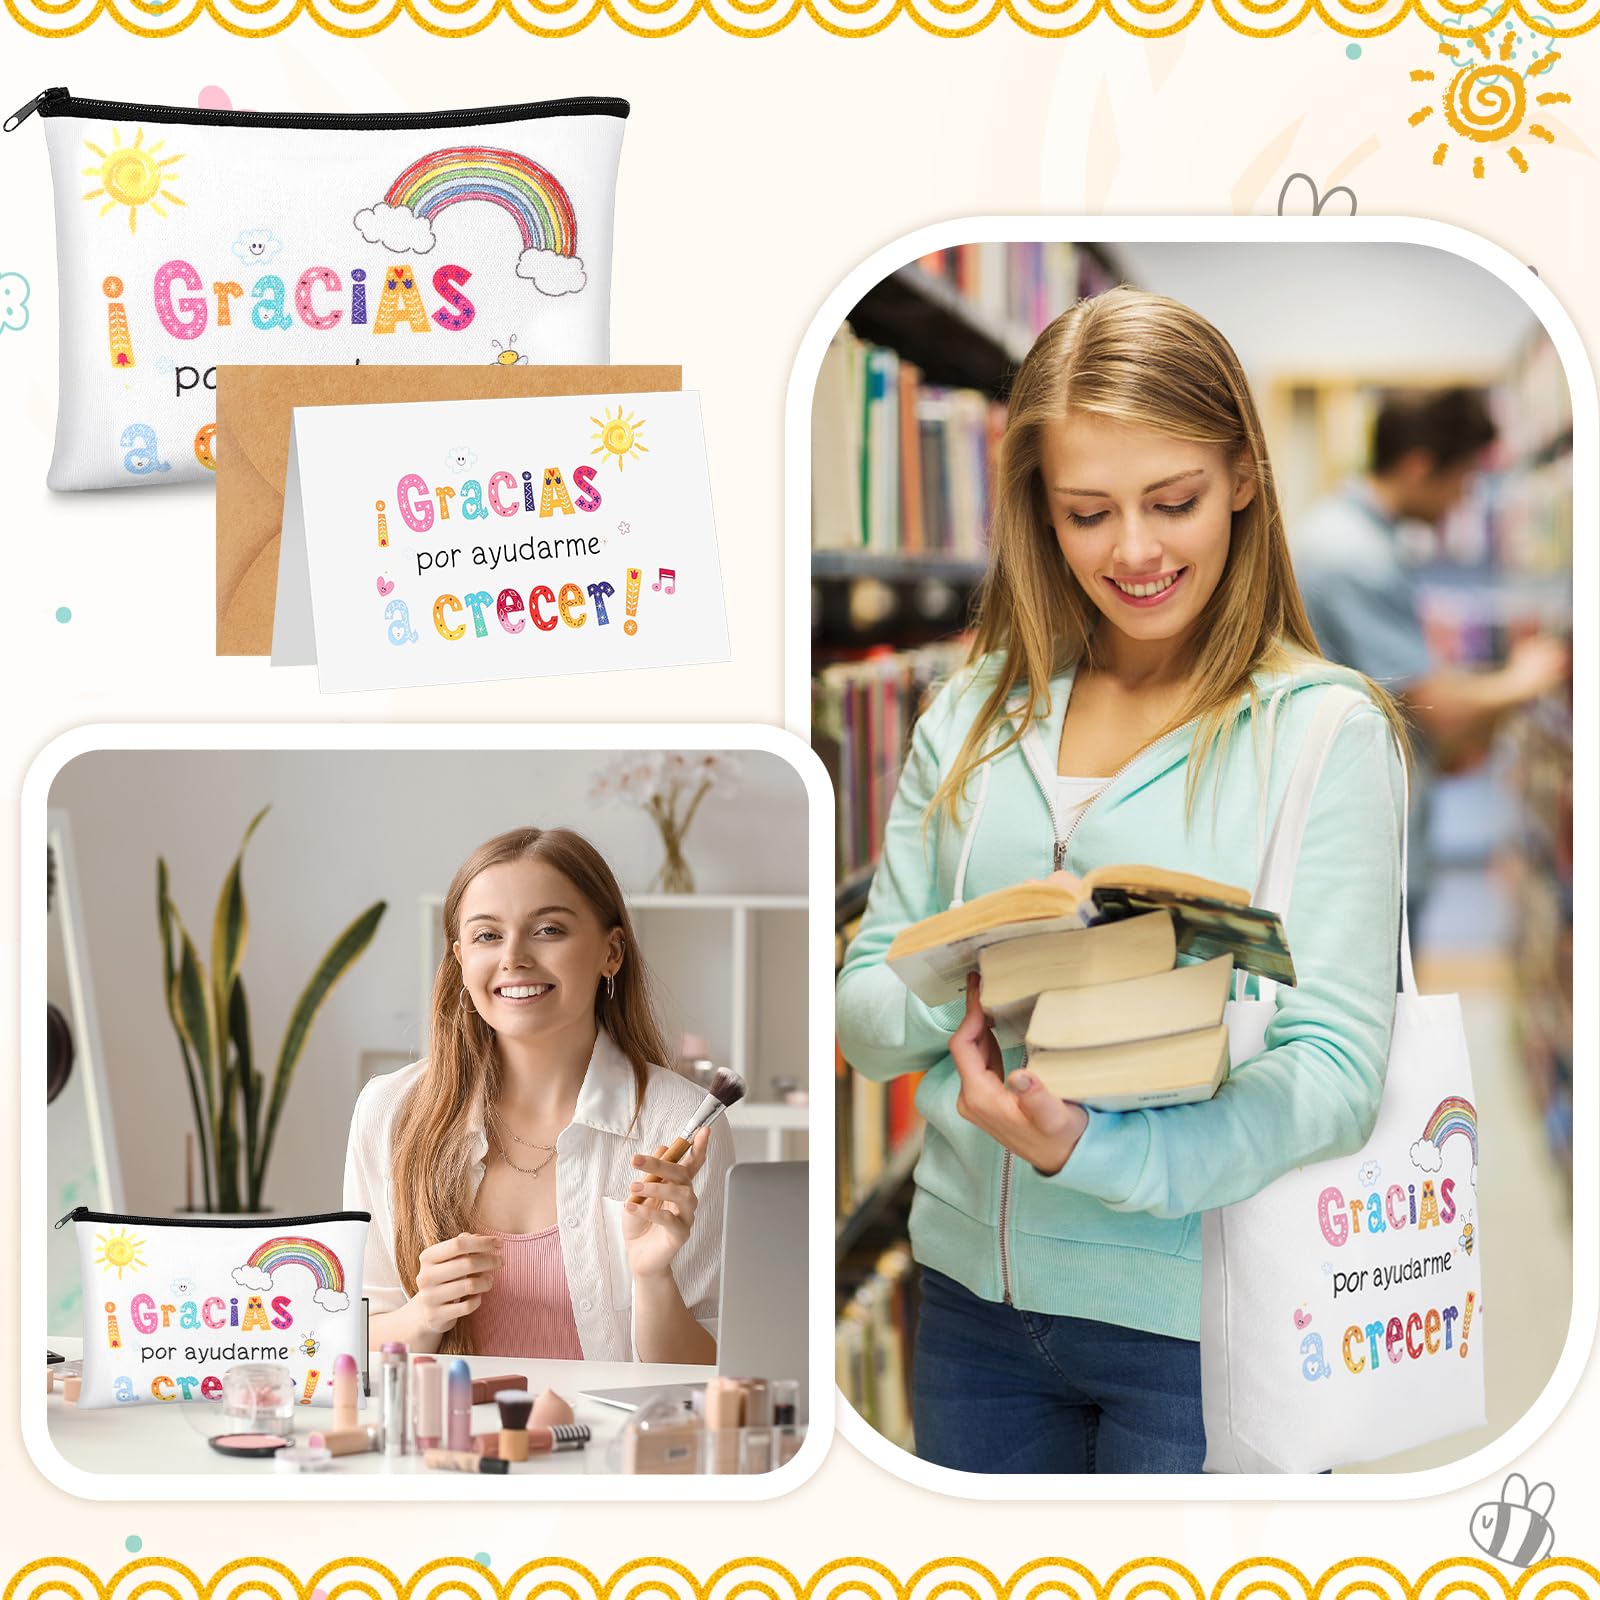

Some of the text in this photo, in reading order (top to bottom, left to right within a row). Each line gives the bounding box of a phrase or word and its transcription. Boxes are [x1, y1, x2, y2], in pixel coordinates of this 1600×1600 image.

[175, 366, 216, 397] po
[120, 423, 172, 475] a
[416, 536, 601, 576] por ayudarme
[384, 567, 642, 646] a crecer!
[1332, 1251, 1452, 1298] por ayudarme
[141, 1343, 289, 1364] por ayudarme
[1300, 1290, 1475, 1382] a crecer!
[113, 1376, 140, 1402] a
